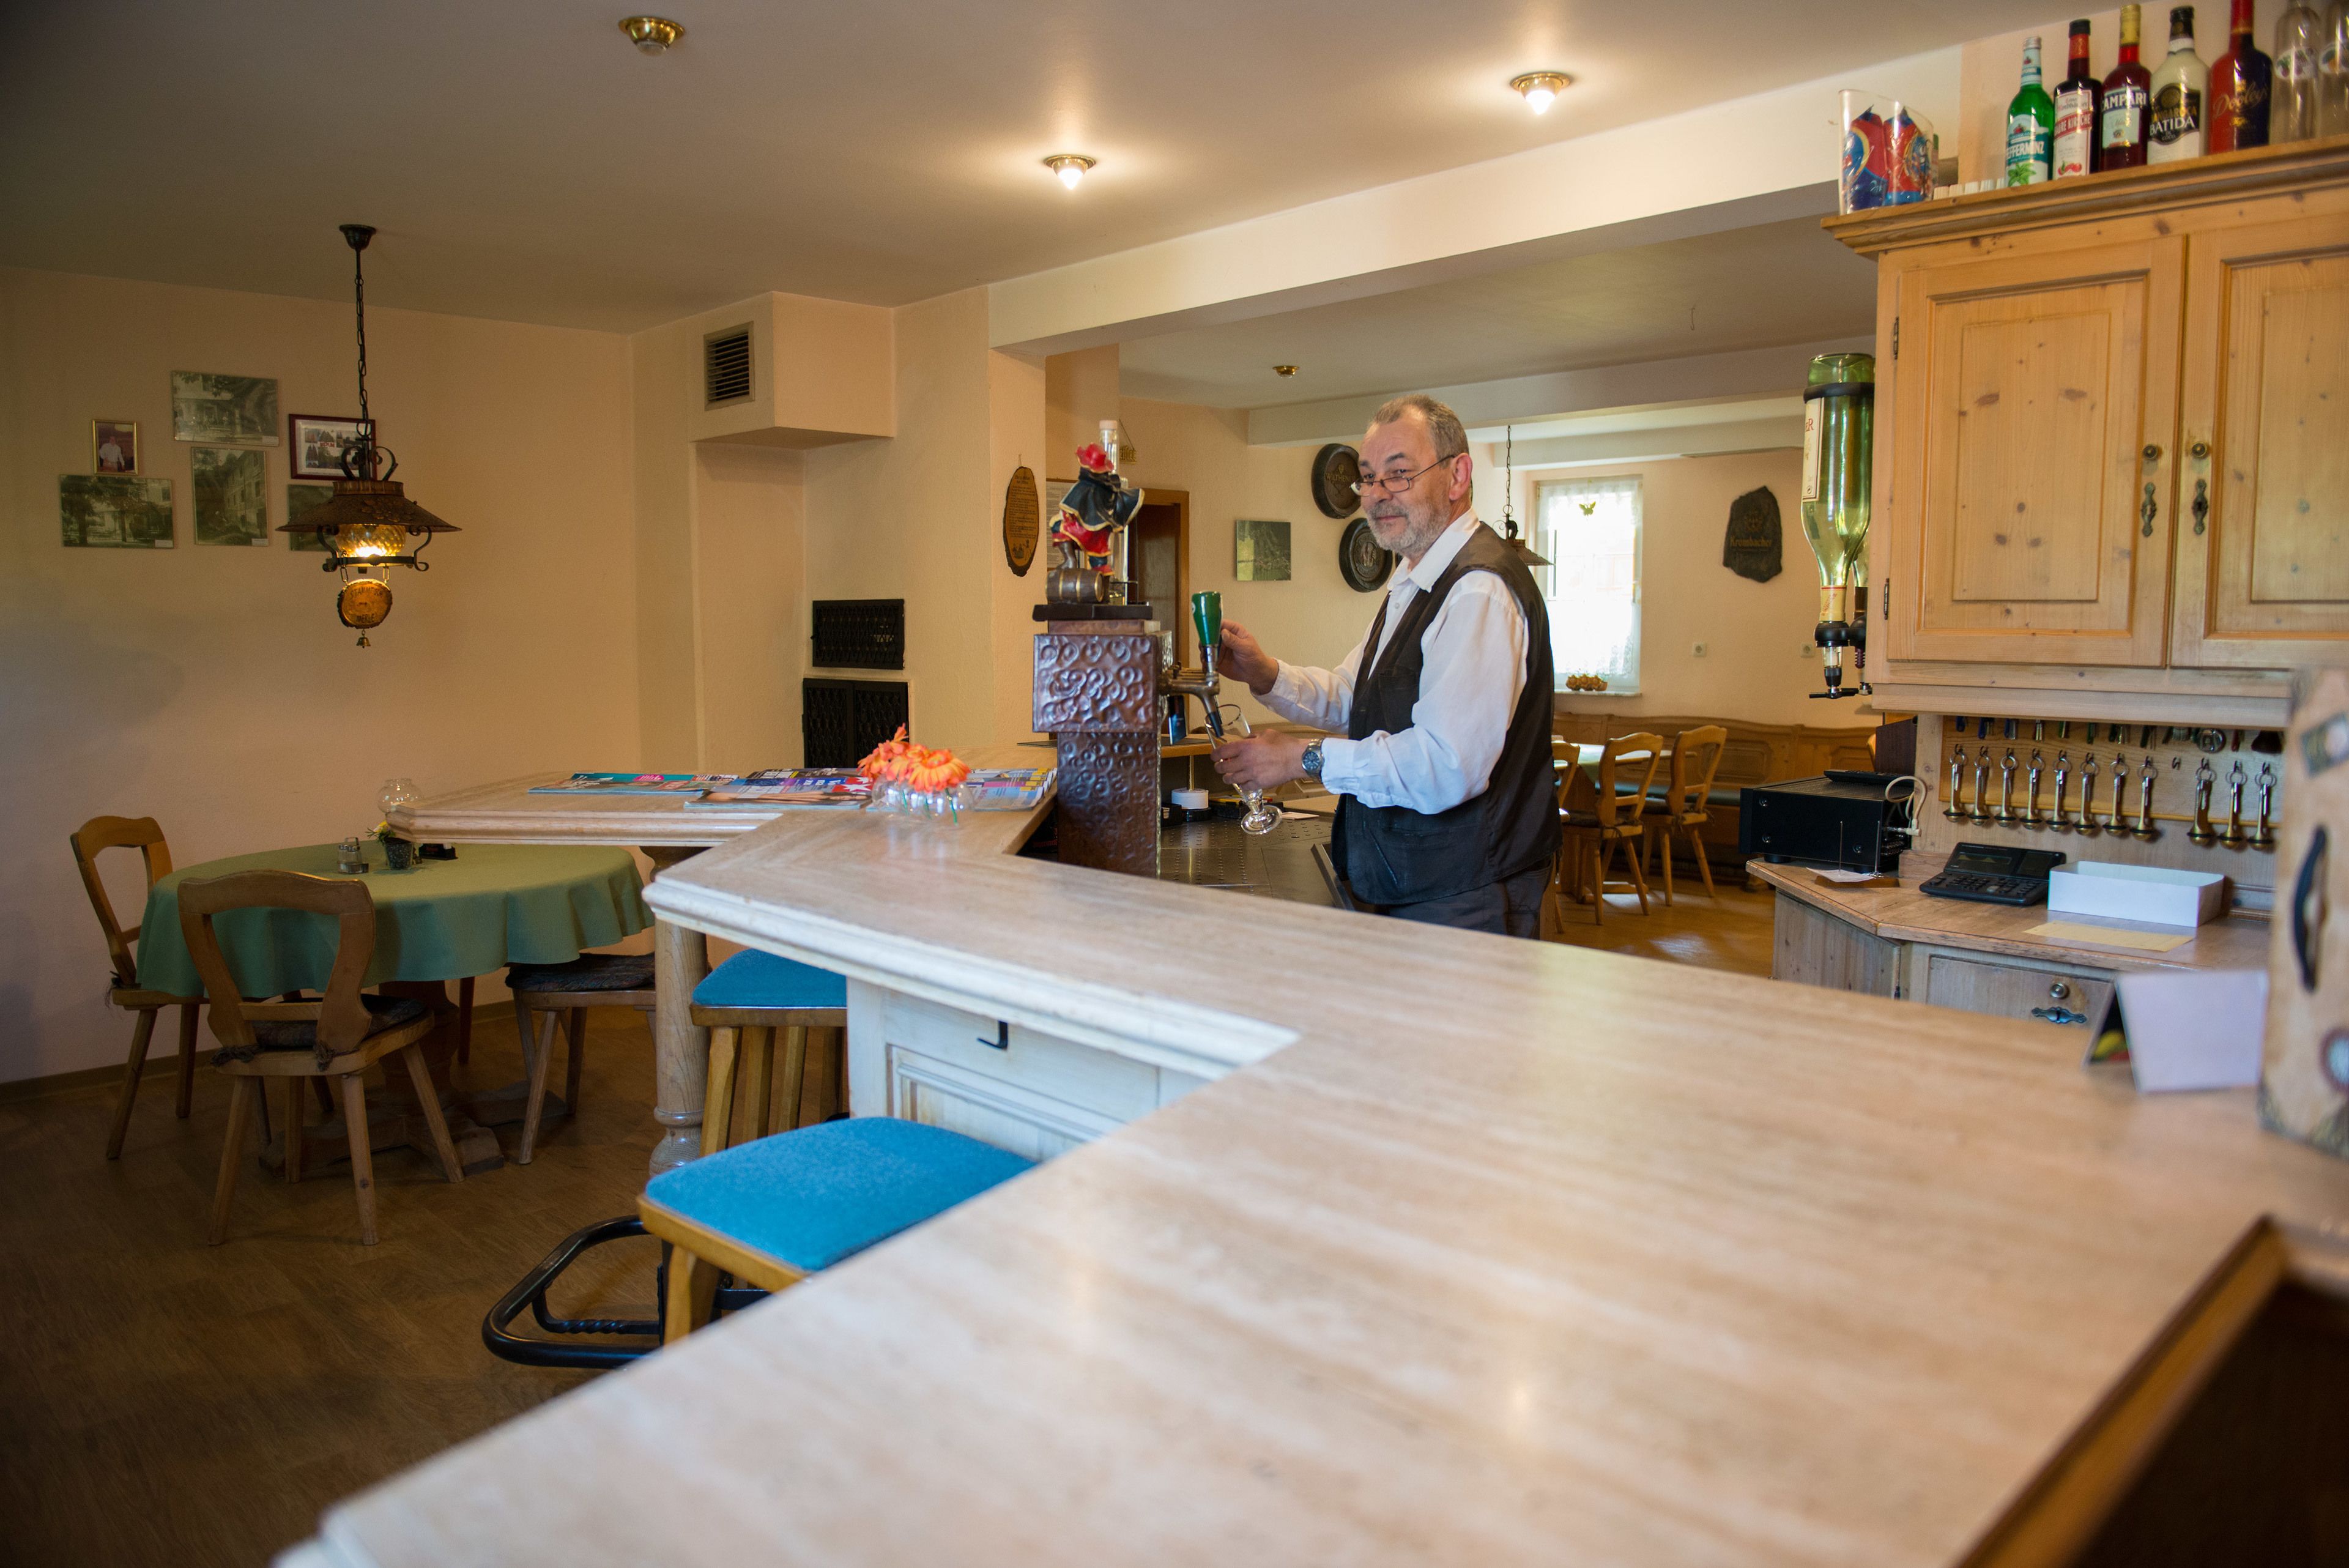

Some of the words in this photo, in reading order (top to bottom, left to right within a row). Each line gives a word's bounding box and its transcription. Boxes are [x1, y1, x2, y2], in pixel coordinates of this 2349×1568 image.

[2068, 114, 2090, 129] KIRCHE
[2150, 116, 2195, 135] BATIDA
[1730, 534, 1772, 548] Krombacher
